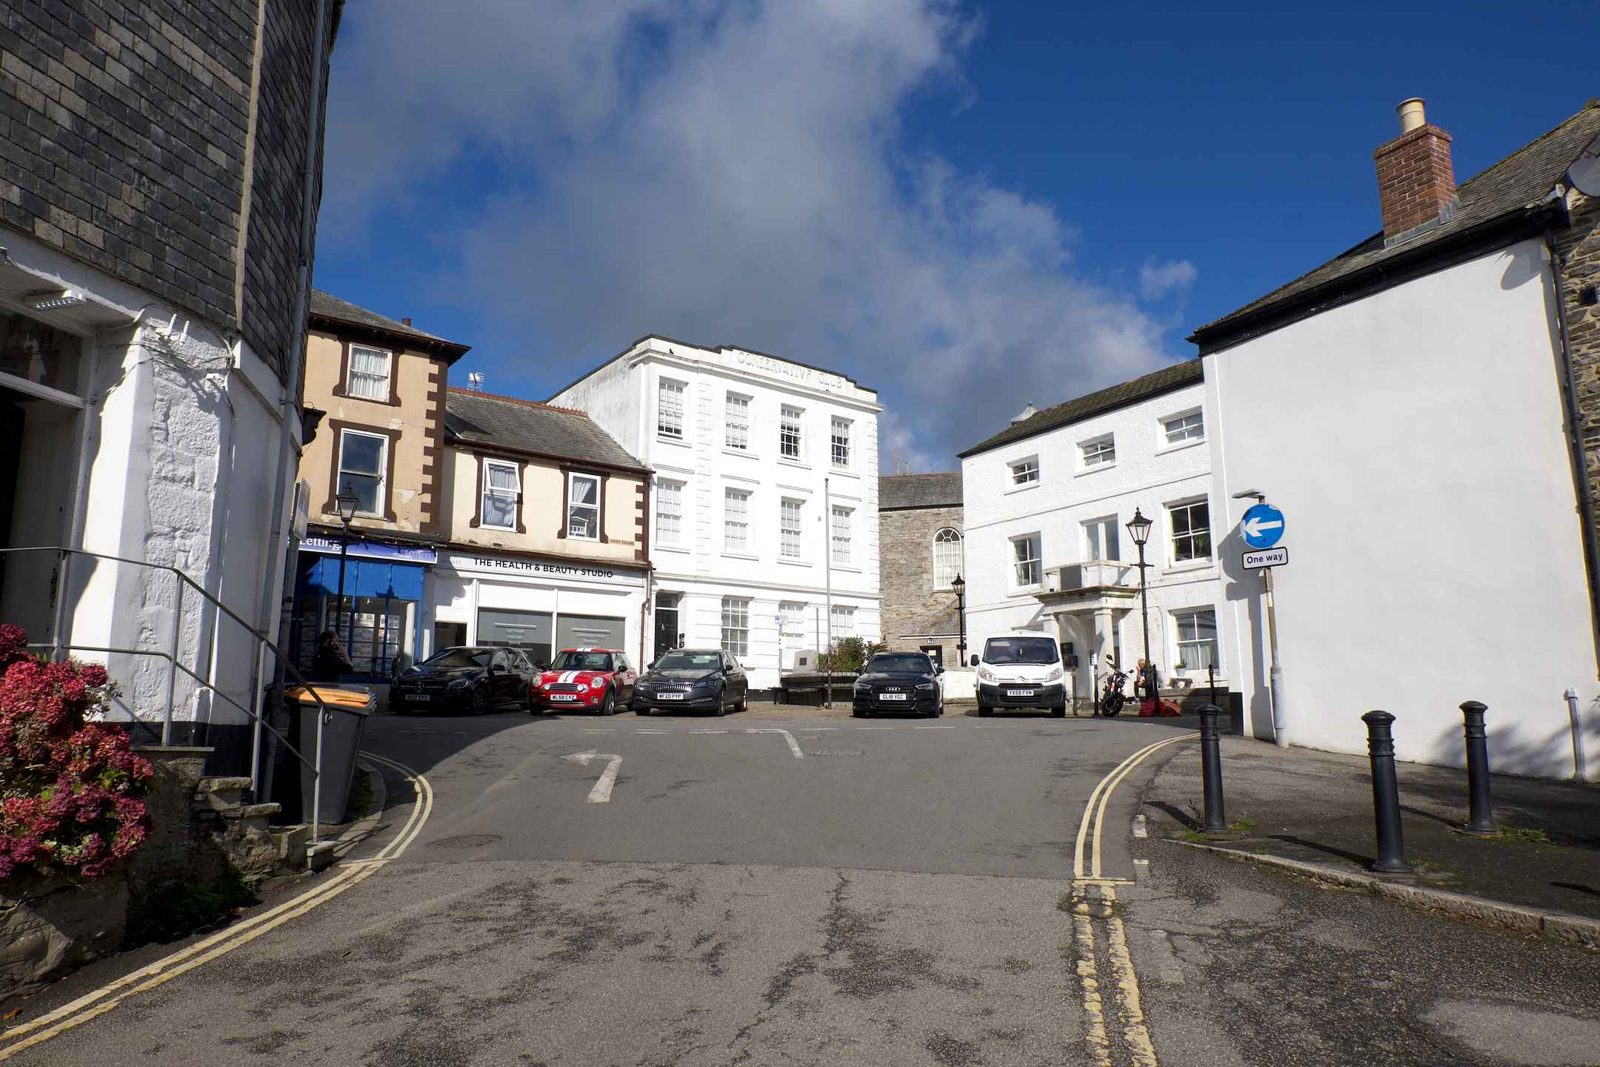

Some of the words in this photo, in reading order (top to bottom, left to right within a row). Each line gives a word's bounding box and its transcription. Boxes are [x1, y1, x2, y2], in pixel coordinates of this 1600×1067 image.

[1246, 556, 1264, 564] One
[1265, 553, 1283, 561] way
[473, 558, 492, 567] THE
[495, 559, 532, 571] HEALTH
[543, 563, 579, 576] BEAUTY
[580, 568, 613, 579] STUDIO
